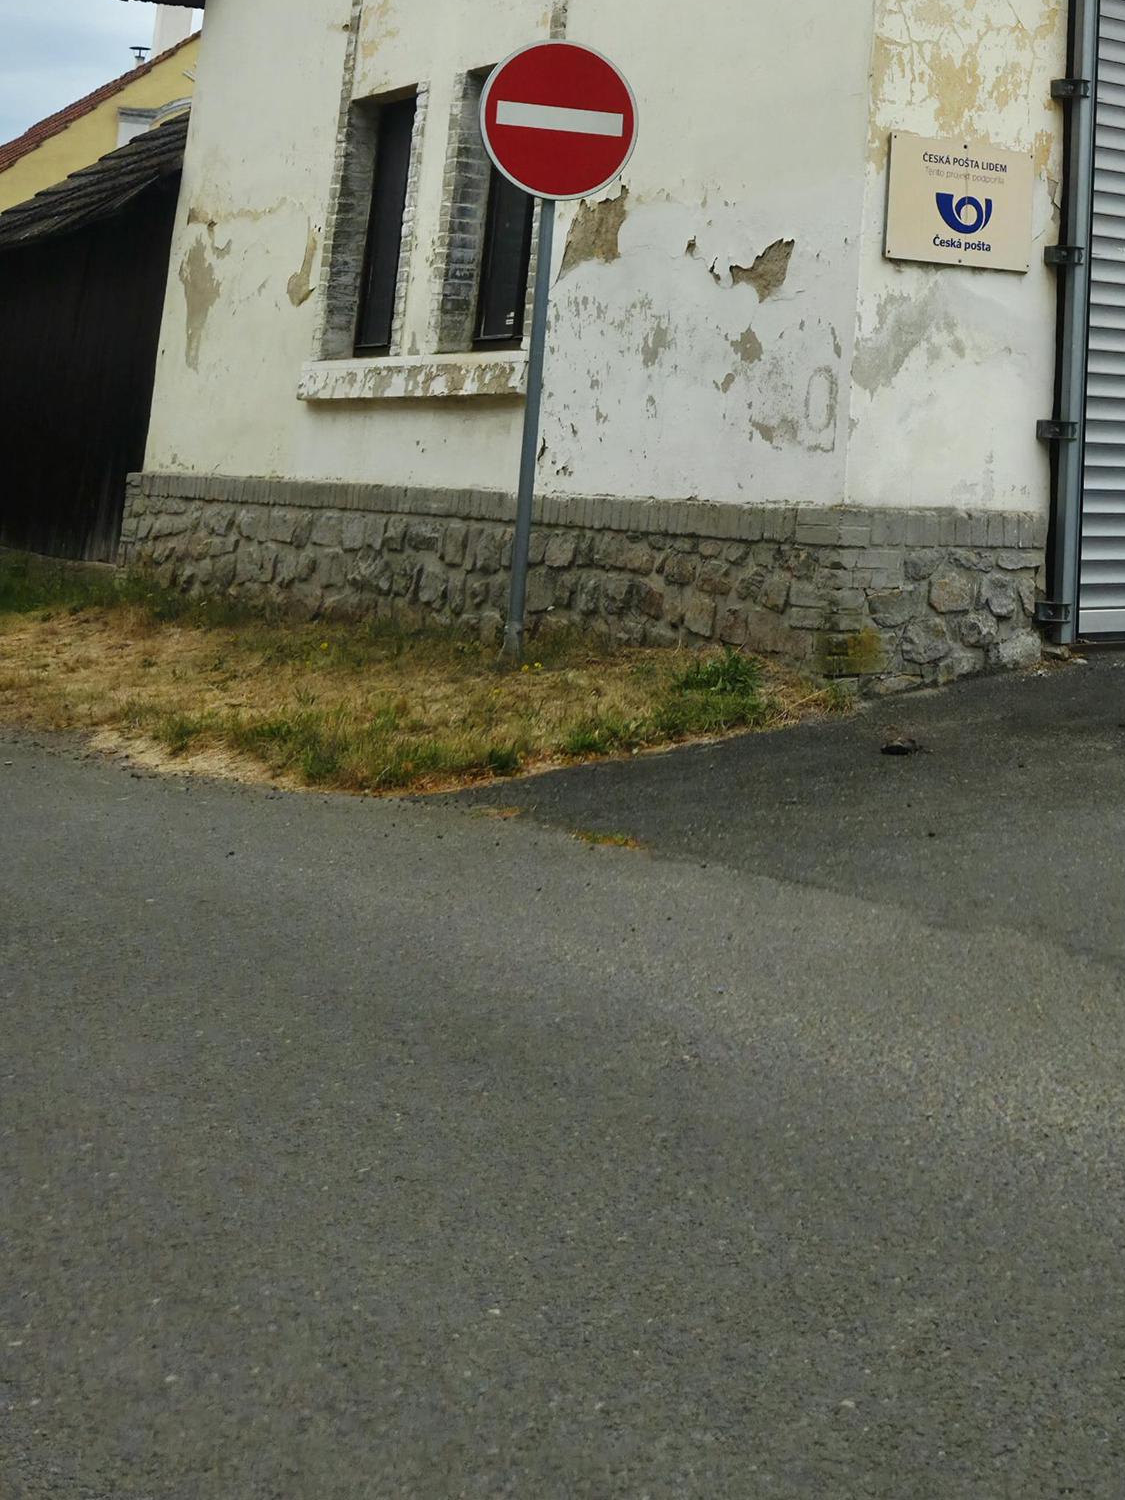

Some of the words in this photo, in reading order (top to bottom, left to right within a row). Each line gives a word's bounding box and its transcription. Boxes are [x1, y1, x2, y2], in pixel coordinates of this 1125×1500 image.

[922, 152, 951, 165] ČESKÁ
[952, 157, 980, 170] POŠTA
[981, 161, 1008, 173] LIDEM
[932, 234, 962, 249] Česká
[964, 237, 991, 252] pošta
